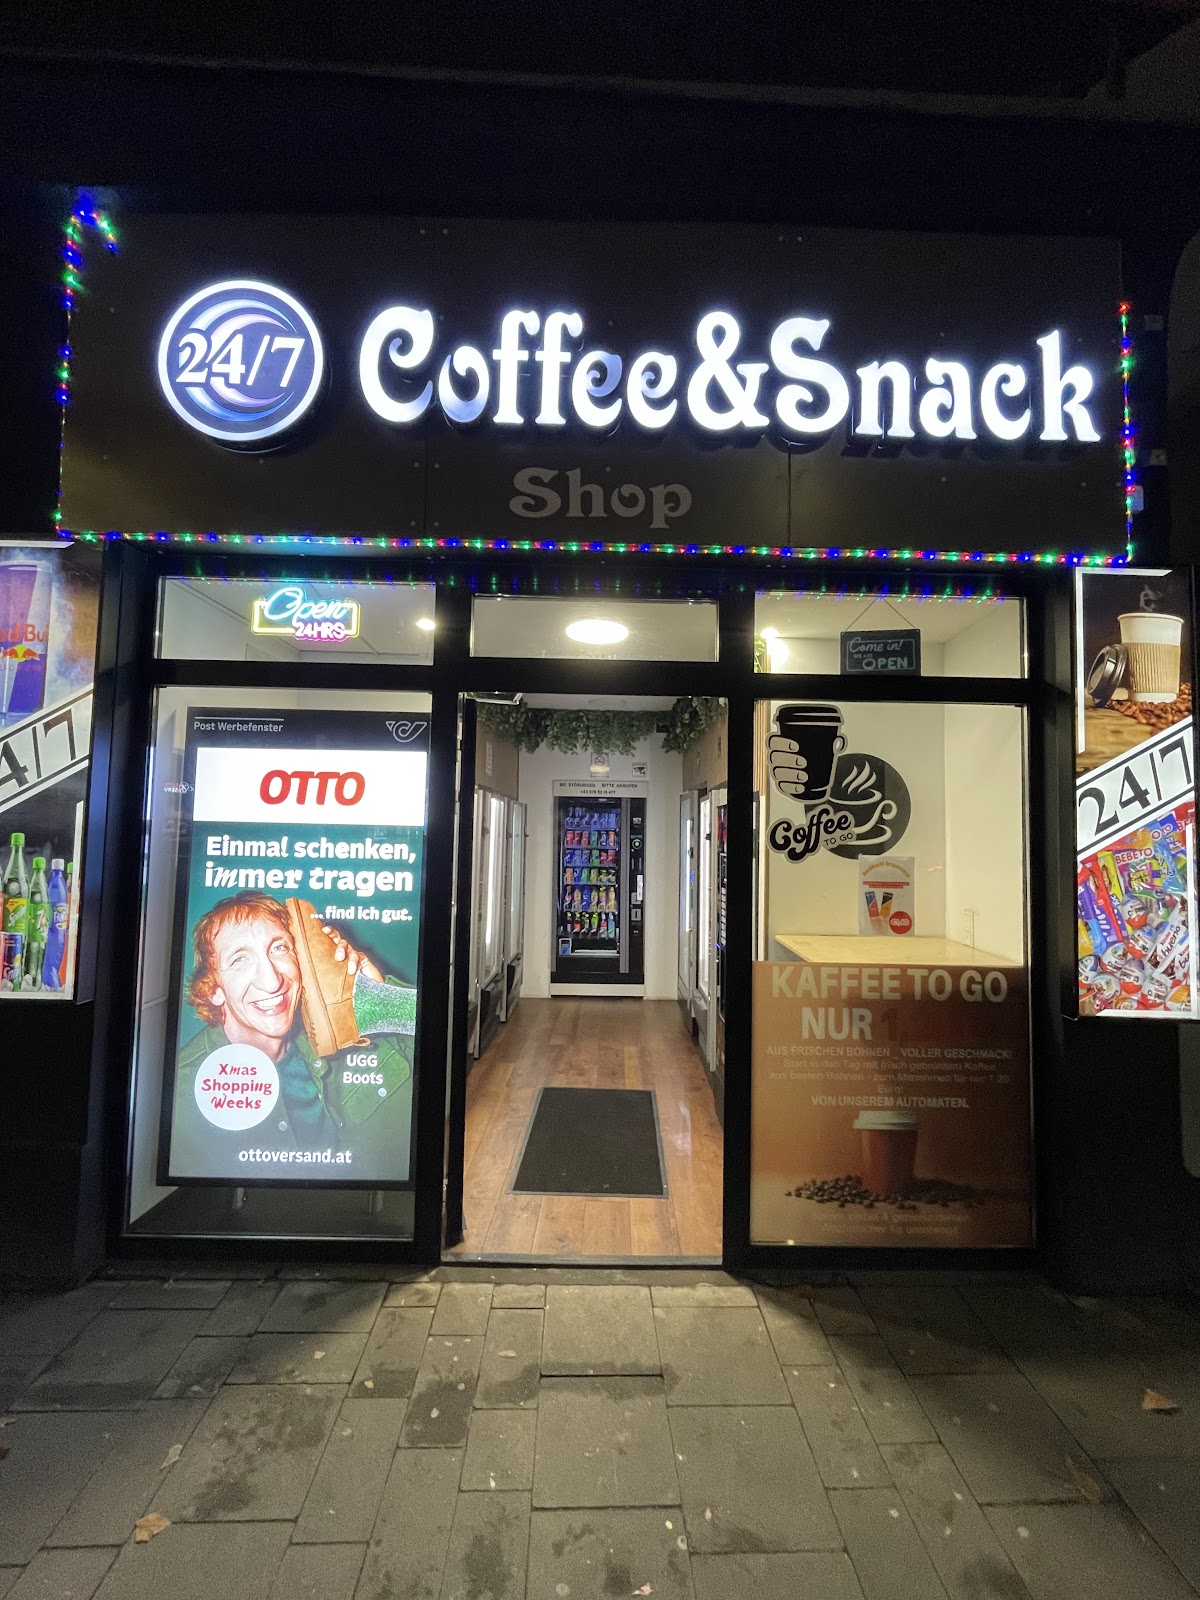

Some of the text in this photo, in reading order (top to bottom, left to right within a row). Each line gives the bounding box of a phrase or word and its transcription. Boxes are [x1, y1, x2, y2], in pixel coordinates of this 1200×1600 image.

[175, 332, 305, 388] 24/7
[358, 306, 1102, 442] Coffee&Snack
[508, 466, 693, 530] Shop
[263, 586, 350, 627] Open
[294, 621, 347, 640] 24HRS
[849, 636, 903, 653] Come in!
[862, 656, 908, 670] OPEN
[193, 720, 284, 732] Post Werbefenster
[0, 707, 77, 789] 4/7
[259, 769, 366, 807] OTTO
[1078, 735, 1193, 836] 24/7
[769, 807, 852, 861] Coffee
[823, 832, 854, 847] TO GO
[206, 834, 417, 864] Einmal schenken,
[1114, 847, 1154, 865] BEBETO
[204, 860, 414, 898] immer tragen
[358, 906, 380, 920] ich
[381, 907, 413, 924] gut.
[1160, 925, 1181, 958] bueno
[770, 965, 1008, 1003] KAFFEE TO GO
[801, 1006, 873, 1041] NUR
[346, 1054, 378, 1067] UGG
[766, 1045, 788, 1056] AUS
[791, 1045, 844, 1057] FRISCHEN
[846, 1046, 890, 1057] BOHNEN
[901, 1047, 942, 1058] VOLLER
[218, 1063, 258, 1076] Xmas
[843, 1059, 861, 1070] Tag
[201, 1078, 273, 1095] Shopping
[342, 1071, 384, 1085] Boots
[210, 1093, 262, 1110] Weeks
[810, 1095, 837, 1106] VON
[838, 1095, 894, 1107] UNSEREM
[238, 1147, 353, 1164] ottoversand.at
